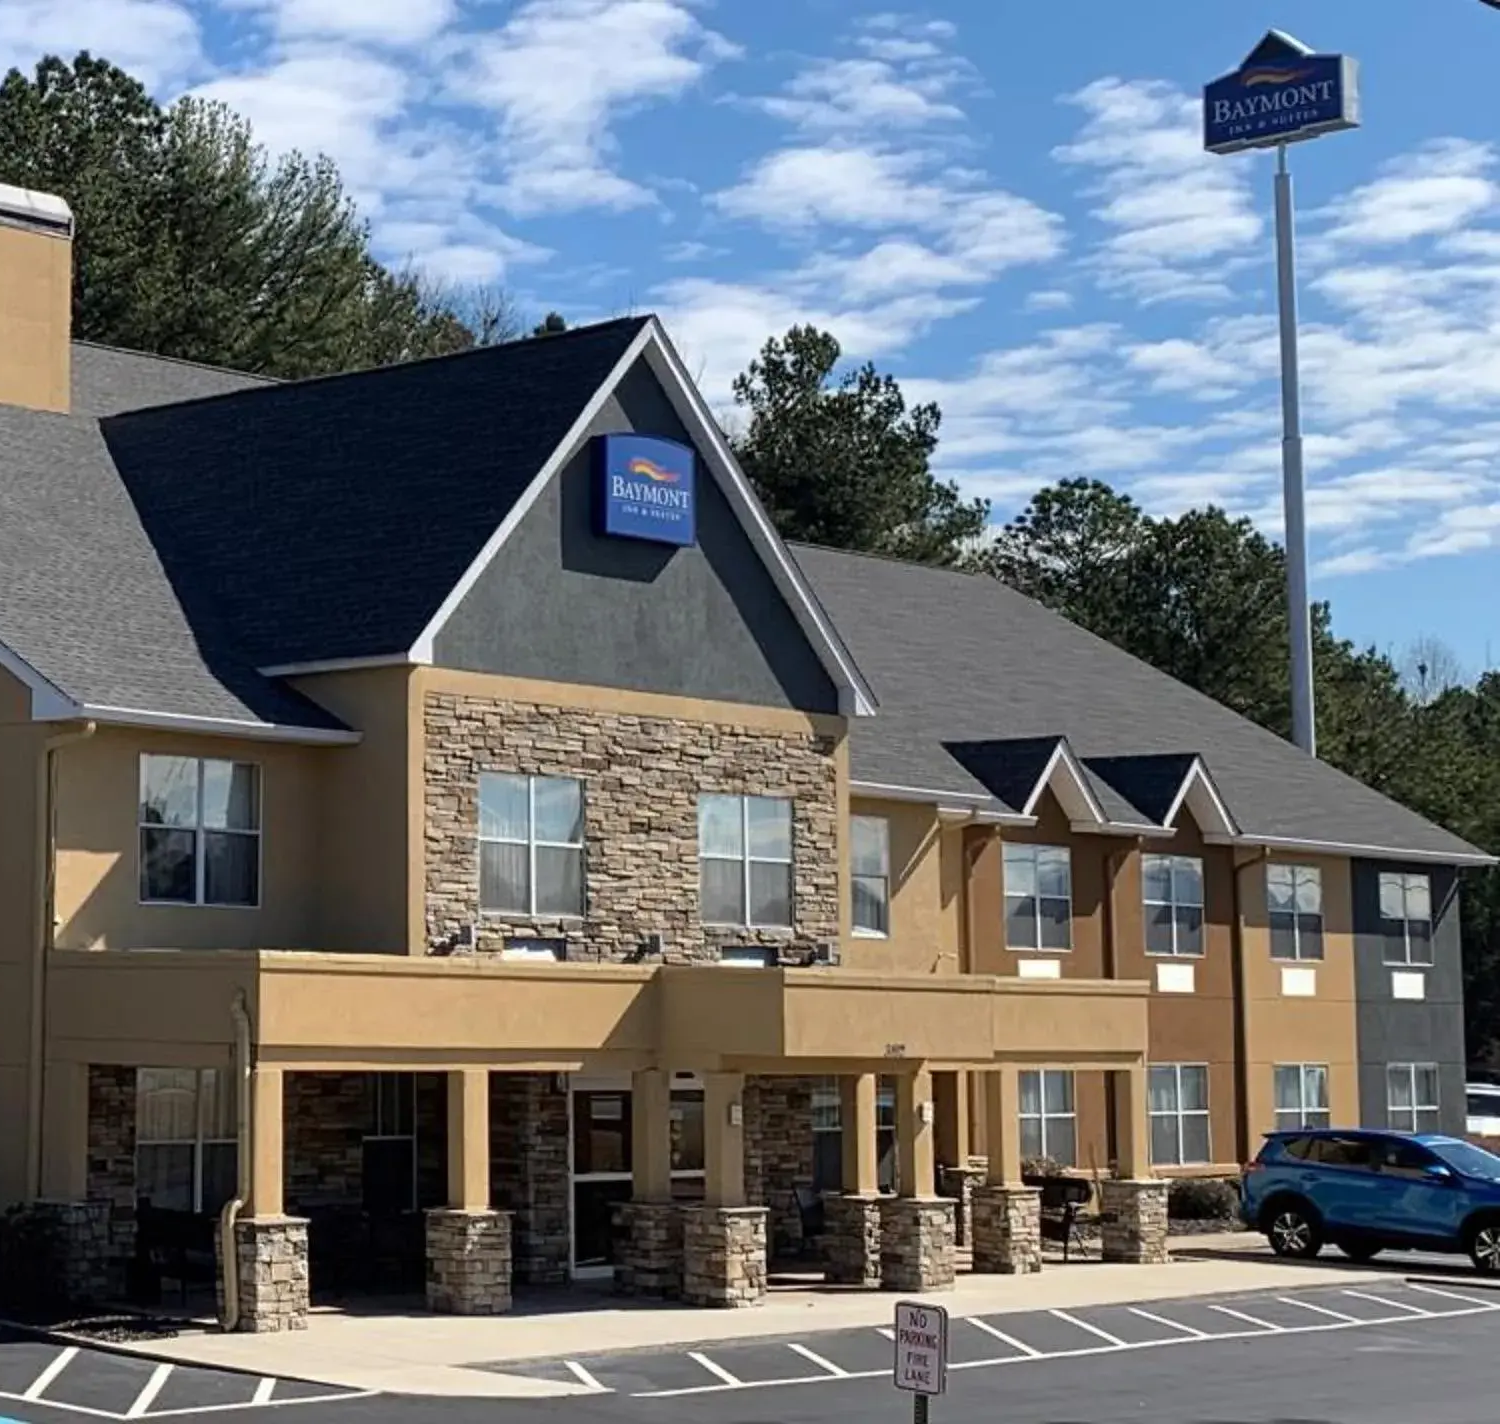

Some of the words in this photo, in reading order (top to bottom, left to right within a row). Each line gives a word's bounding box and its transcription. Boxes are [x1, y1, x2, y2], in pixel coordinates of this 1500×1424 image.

[1213, 80, 1333, 123] BAYMONT
[612, 475, 690, 509] BAYMONT
[909, 1311, 928, 1329] NO
